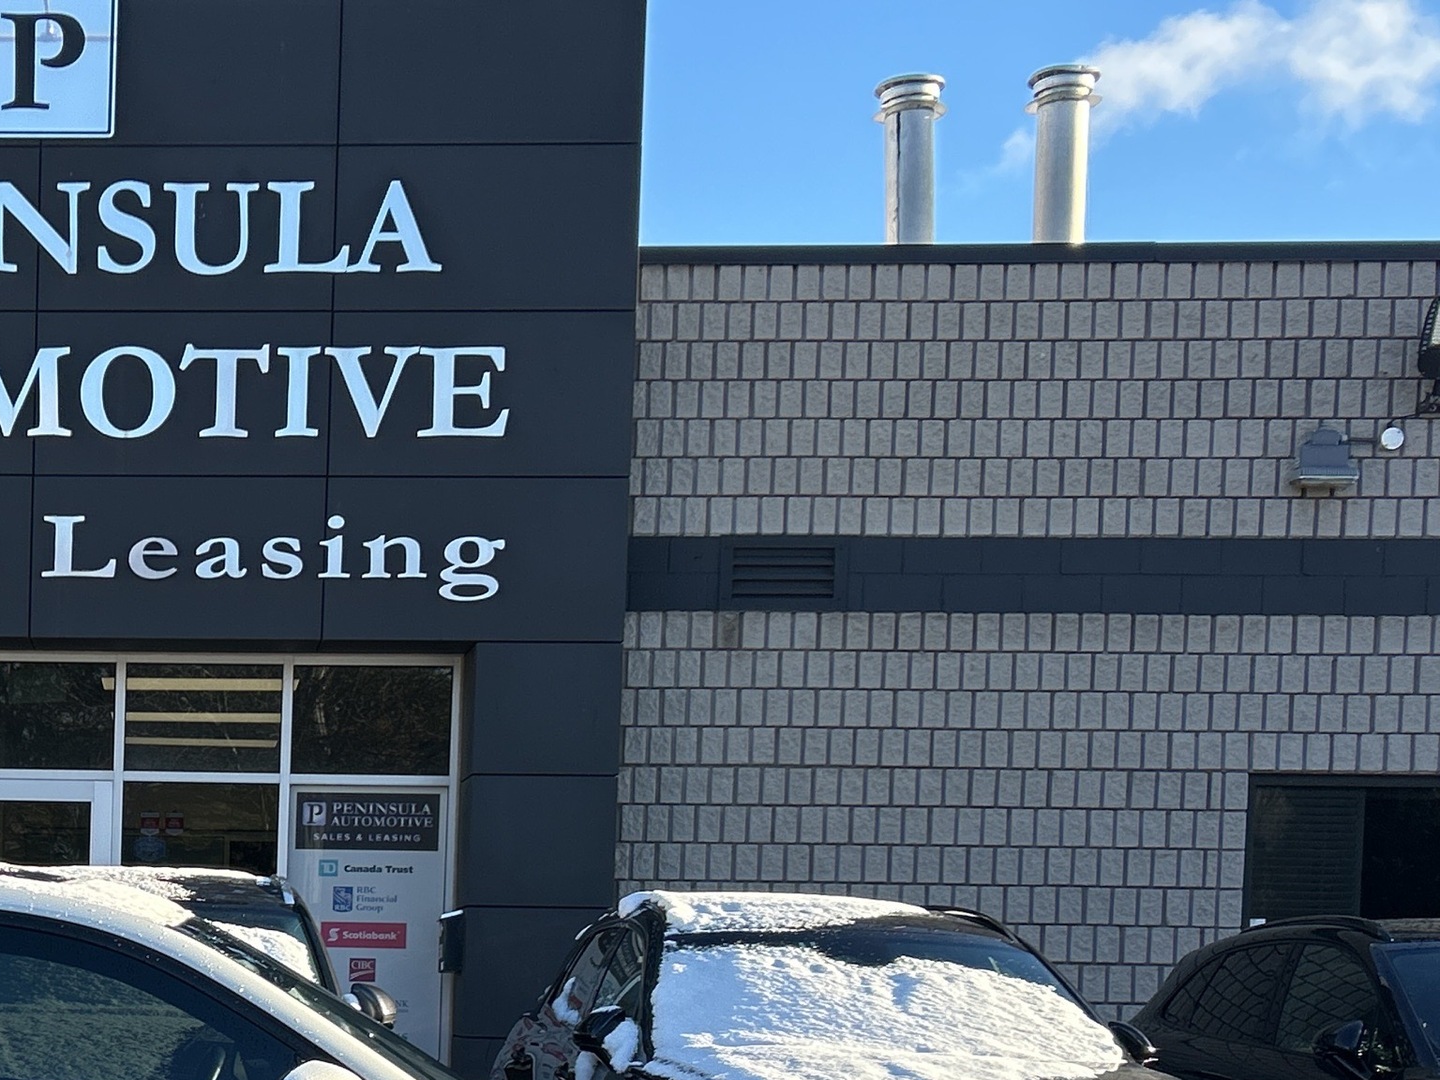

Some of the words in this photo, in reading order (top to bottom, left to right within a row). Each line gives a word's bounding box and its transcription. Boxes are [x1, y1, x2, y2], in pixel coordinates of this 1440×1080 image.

[0, 13, 86, 111] P
[41, 514, 507, 602] Leasing
[307, 803, 323, 824] P
[332, 802, 431, 815] PENINSULA
[331, 815, 433, 828] AUTOMOTIVE
[313, 833, 351, 841] SALES
[355, 833, 363, 842] &
[368, 833, 421, 842] LEASING
[320, 862, 337, 874] TD
[344, 865, 382, 873] Canada
[385, 865, 413, 874] Trust
[356, 886, 377, 894] RBC
[356, 895, 398, 903] Financial
[356, 904, 384, 914] Group
[342, 930, 397, 940] Scotiabank
[351, 960, 375, 970] CIBC
